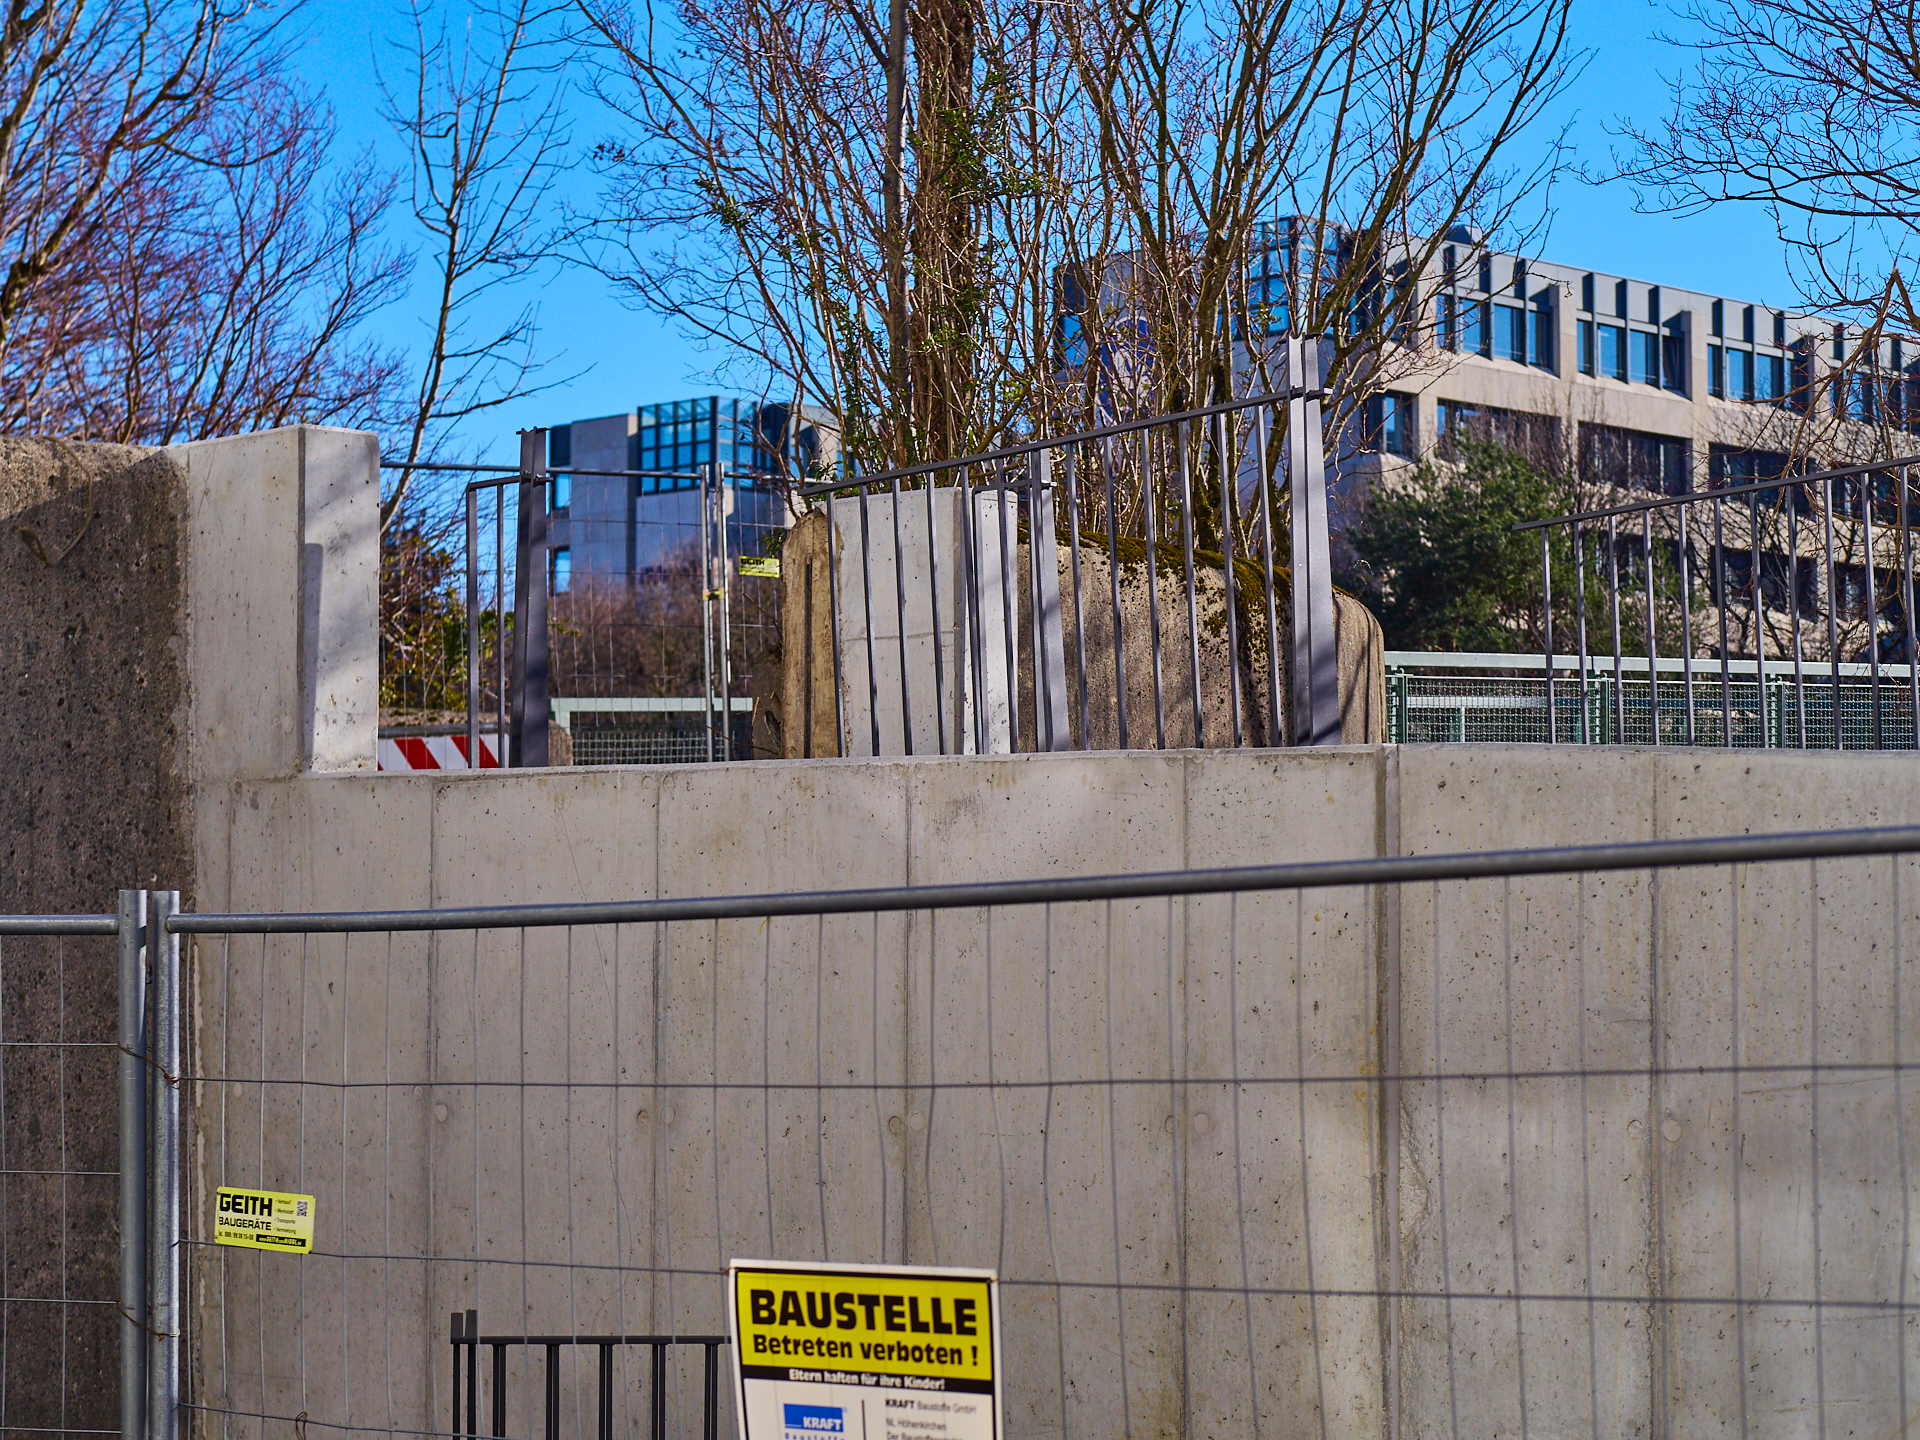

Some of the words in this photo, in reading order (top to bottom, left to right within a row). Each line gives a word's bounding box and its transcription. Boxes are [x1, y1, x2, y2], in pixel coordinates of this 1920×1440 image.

[219, 1193, 273, 1217] GEITH
[218, 1216, 272, 1231] BAUGERÄTE
[276, 1217, 296, 1225] Transporte
[750, 1289, 977, 1336] BAUSTELLE
[753, 1334, 853, 1358] Betreten
[860, 1340, 963, 1366] verboten
[971, 1345, 979, 1366] !
[789, 1368, 823, 1382] Eltern
[823, 1370, 859, 1385] haften
[861, 1372, 878, 1386] für
[879, 1375, 903, 1388] ihre
[904, 1377, 946, 1391] Kinder!
[885, 1399, 915, 1409] KRAFT
[917, 1400, 951, 1412] Baustoffe
[953, 1403, 977, 1414] GmbH
[802, 1416, 842, 1431] KRAFT
